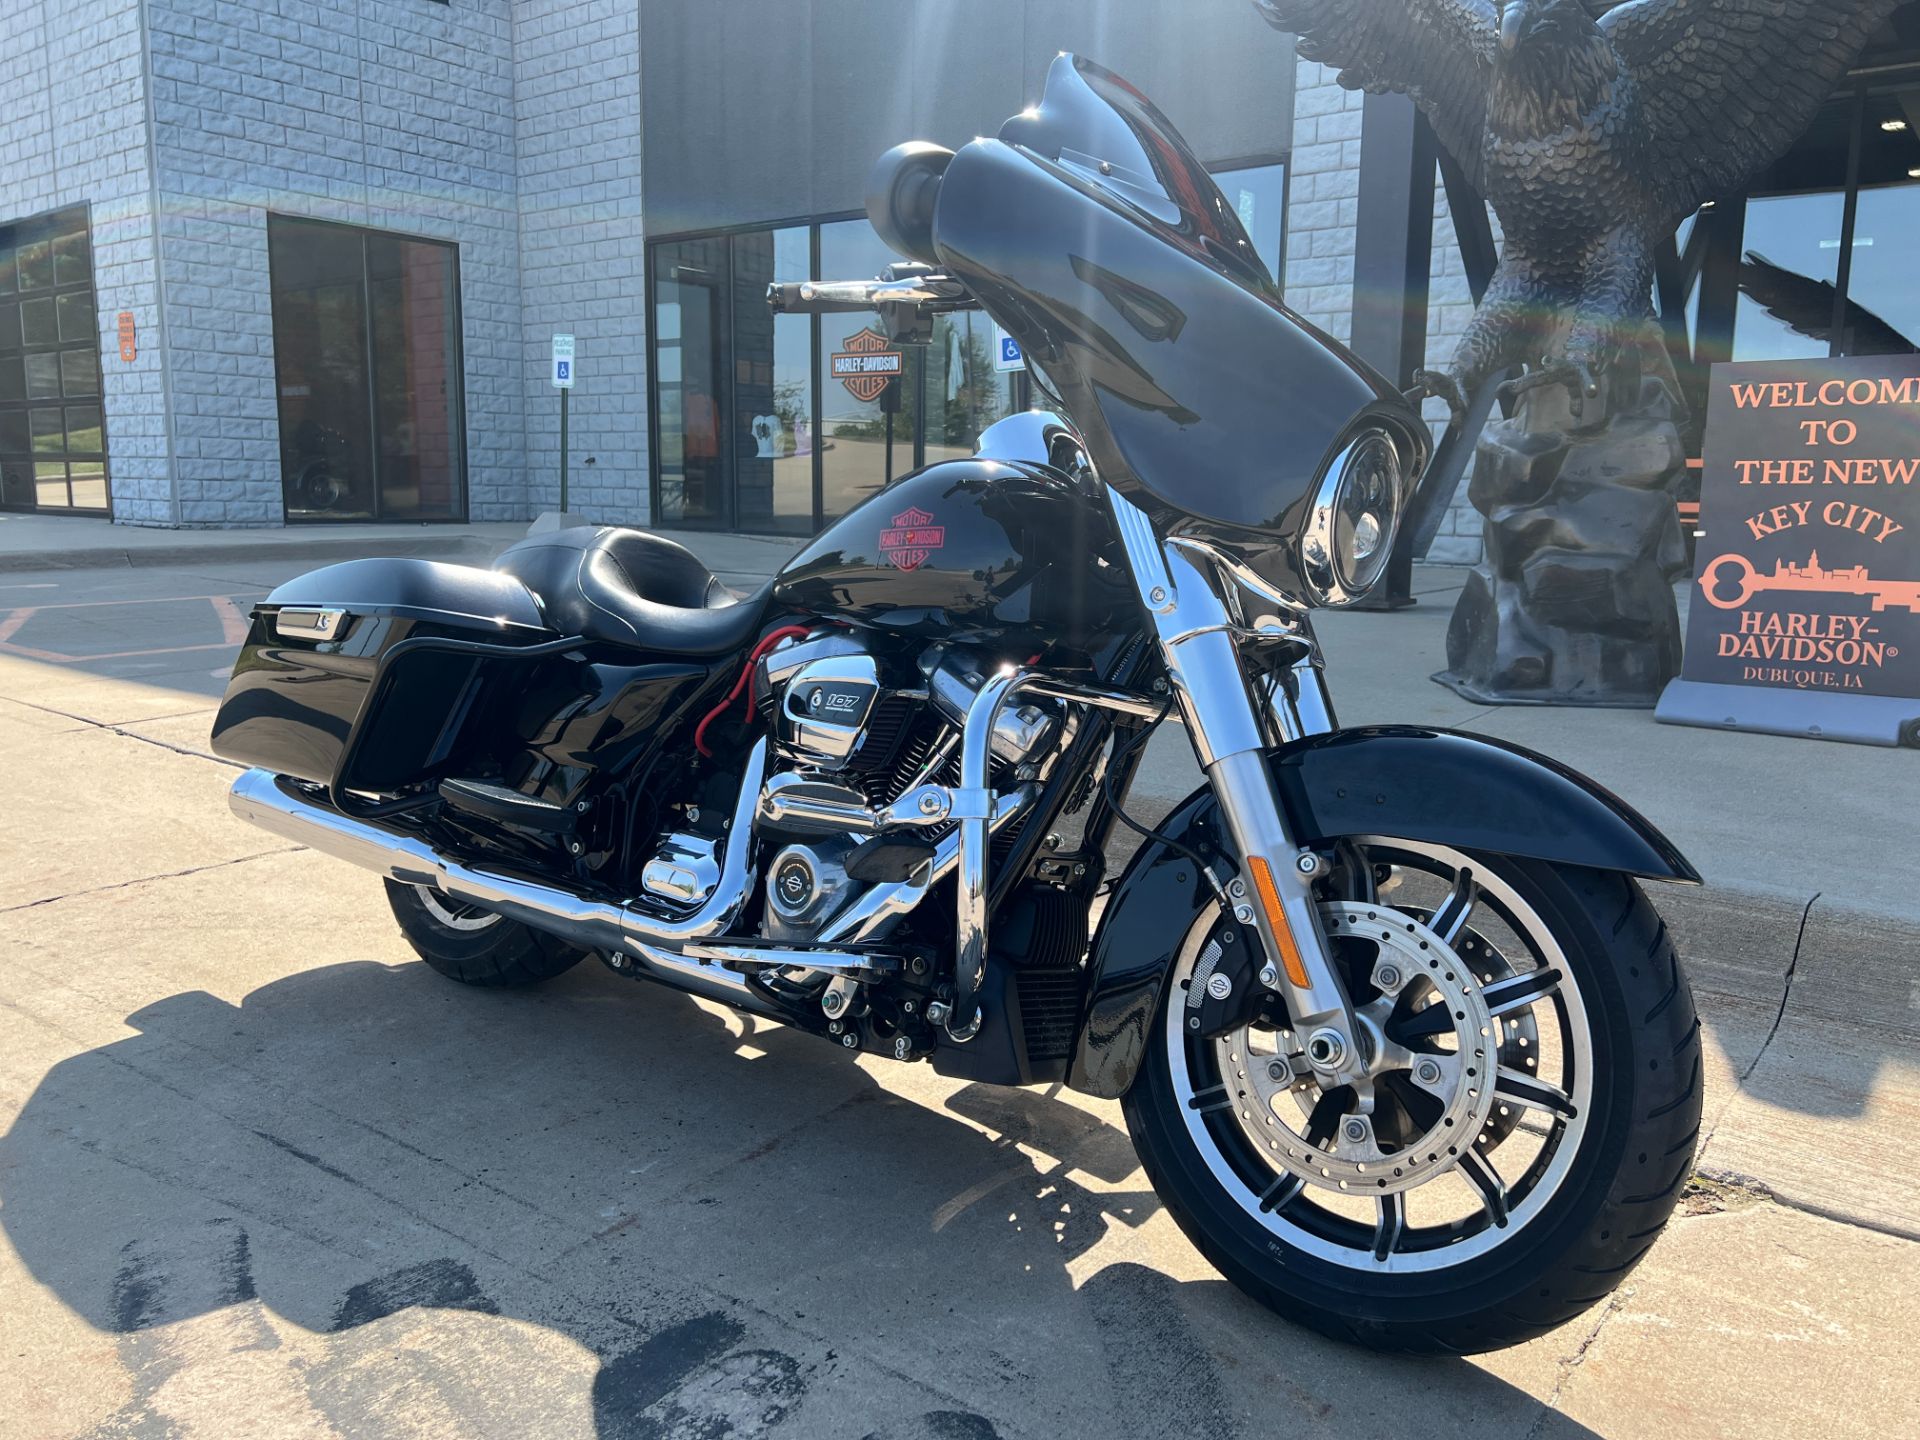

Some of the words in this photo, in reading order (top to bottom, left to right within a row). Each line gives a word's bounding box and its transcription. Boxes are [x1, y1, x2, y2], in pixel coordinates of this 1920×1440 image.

[849, 336, 884, 352] MOTOR
[835, 356, 899, 373] HARLEY-DAVIDSON
[849, 377, 884, 396] CYCLES
[1799, 419, 1858, 446] TO
[1734, 459, 1815, 485] THE
[1822, 458, 1920, 485] NEW
[895, 511, 928, 527] MOTOR
[1745, 500, 1813, 541] KEY
[1822, 501, 1904, 544] CITY
[892, 550, 924, 567] CYCLES
[1739, 610, 1879, 641] HARLEY-
[1743, 666, 1840, 688] DUBUQUE,
[1843, 673, 1864, 688] IA
[826, 693, 861, 708] 107
